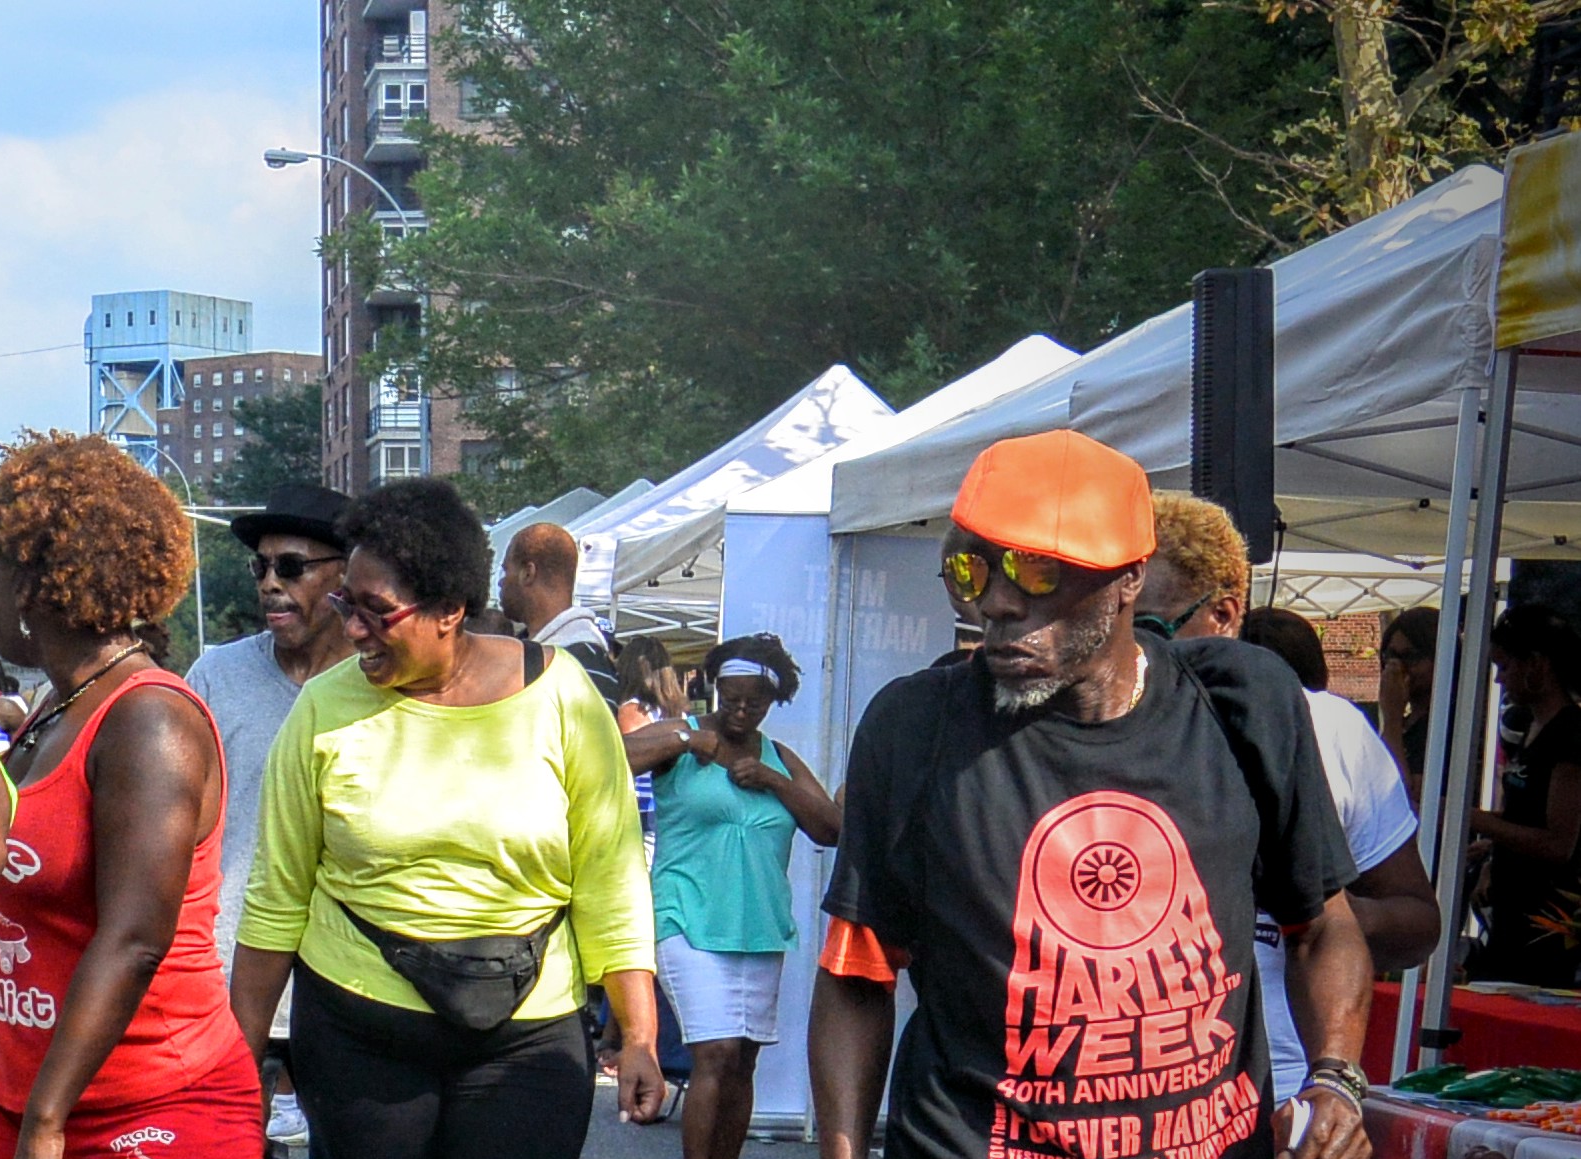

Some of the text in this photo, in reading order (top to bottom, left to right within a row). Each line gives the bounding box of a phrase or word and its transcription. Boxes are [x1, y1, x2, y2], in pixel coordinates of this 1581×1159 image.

[1006, 893, 1226, 1026] HARLEM
[1006, 994, 1236, 1076] WEEK
[998, 1079, 1066, 1104] 40TH
[1009, 1108, 1142, 1159] FOREVER
[1152, 1071, 1261, 1150] HARLEM
